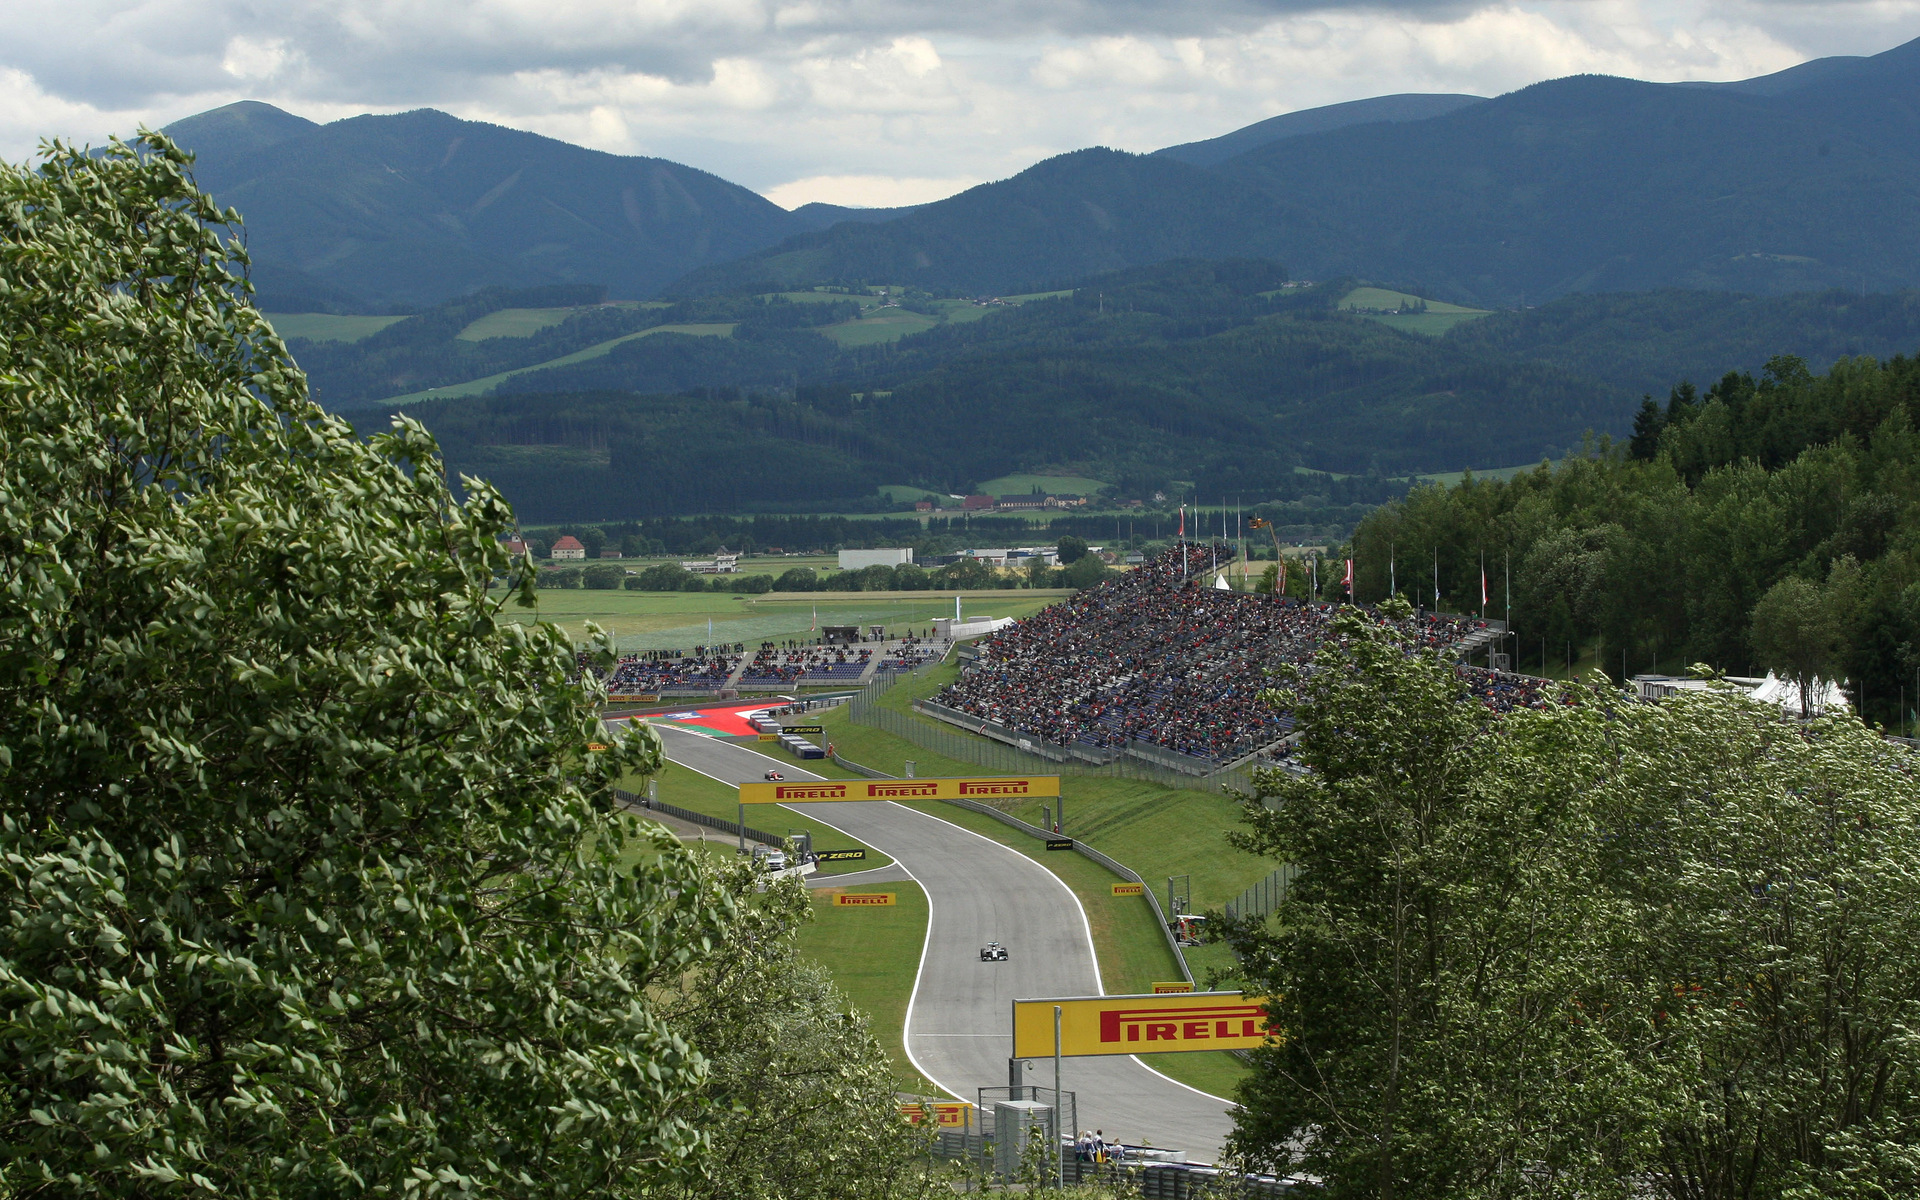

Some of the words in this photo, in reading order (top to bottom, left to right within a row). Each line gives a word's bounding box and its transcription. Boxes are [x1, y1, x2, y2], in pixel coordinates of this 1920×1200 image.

[776, 785, 847, 799] PIRELLI
[868, 783, 938, 797] PIRELLI
[959, 781, 1029, 795] PIRELLI
[829, 851, 863, 859] ZERO
[840, 895, 888, 904] PIRELLI
